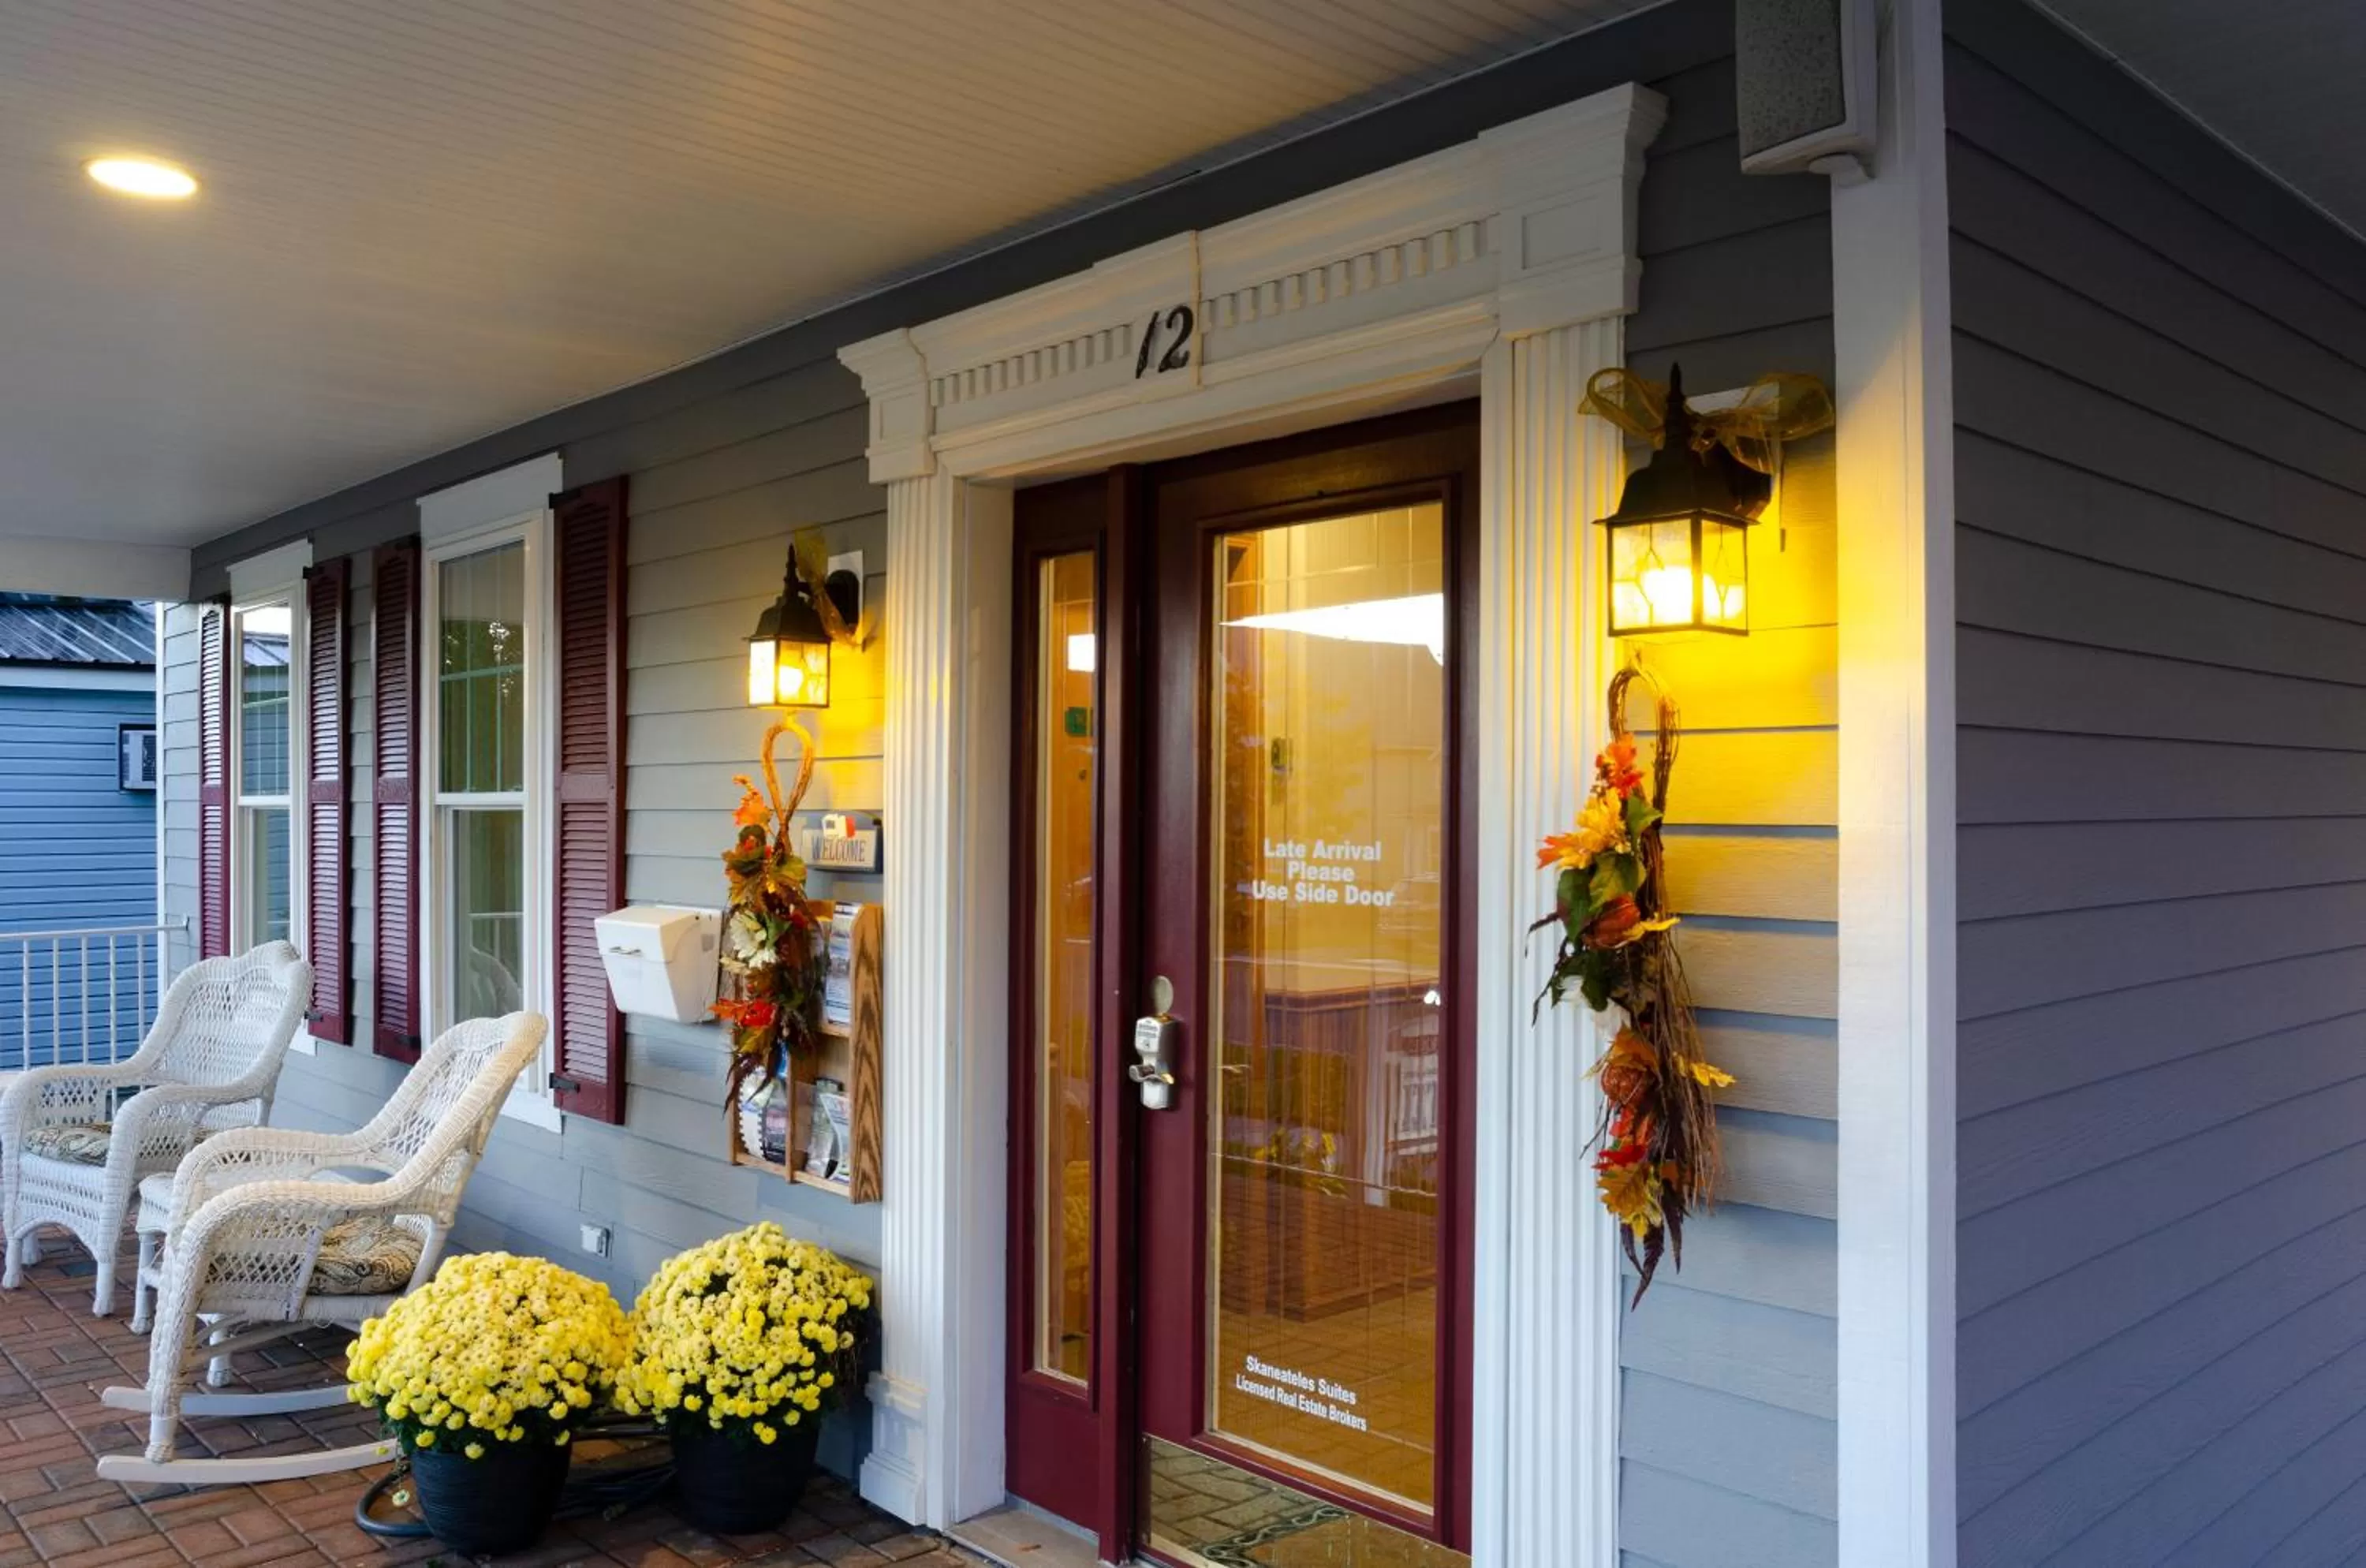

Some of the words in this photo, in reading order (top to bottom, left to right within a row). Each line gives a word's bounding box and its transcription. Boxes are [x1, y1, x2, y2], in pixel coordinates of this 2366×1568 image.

[1135, 305, 1193, 379] 12
[1263, 838, 1306, 859] Late
[1312, 840, 1382, 861] Arrival
[1287, 861, 1355, 883] Please
[1252, 879, 1288, 901] Use
[1295, 883, 1338, 904] Side
[1345, 884, 1395, 906] Door
[1246, 1354, 1315, 1392] Skaneateles
[1318, 1378, 1357, 1406] Suites
[1236, 1374, 1275, 1400] Licensed
[1277, 1387, 1297, 1408] Real
[1298, 1394, 1327, 1419] Estate
[1329, 1404, 1367, 1432] Brokers
